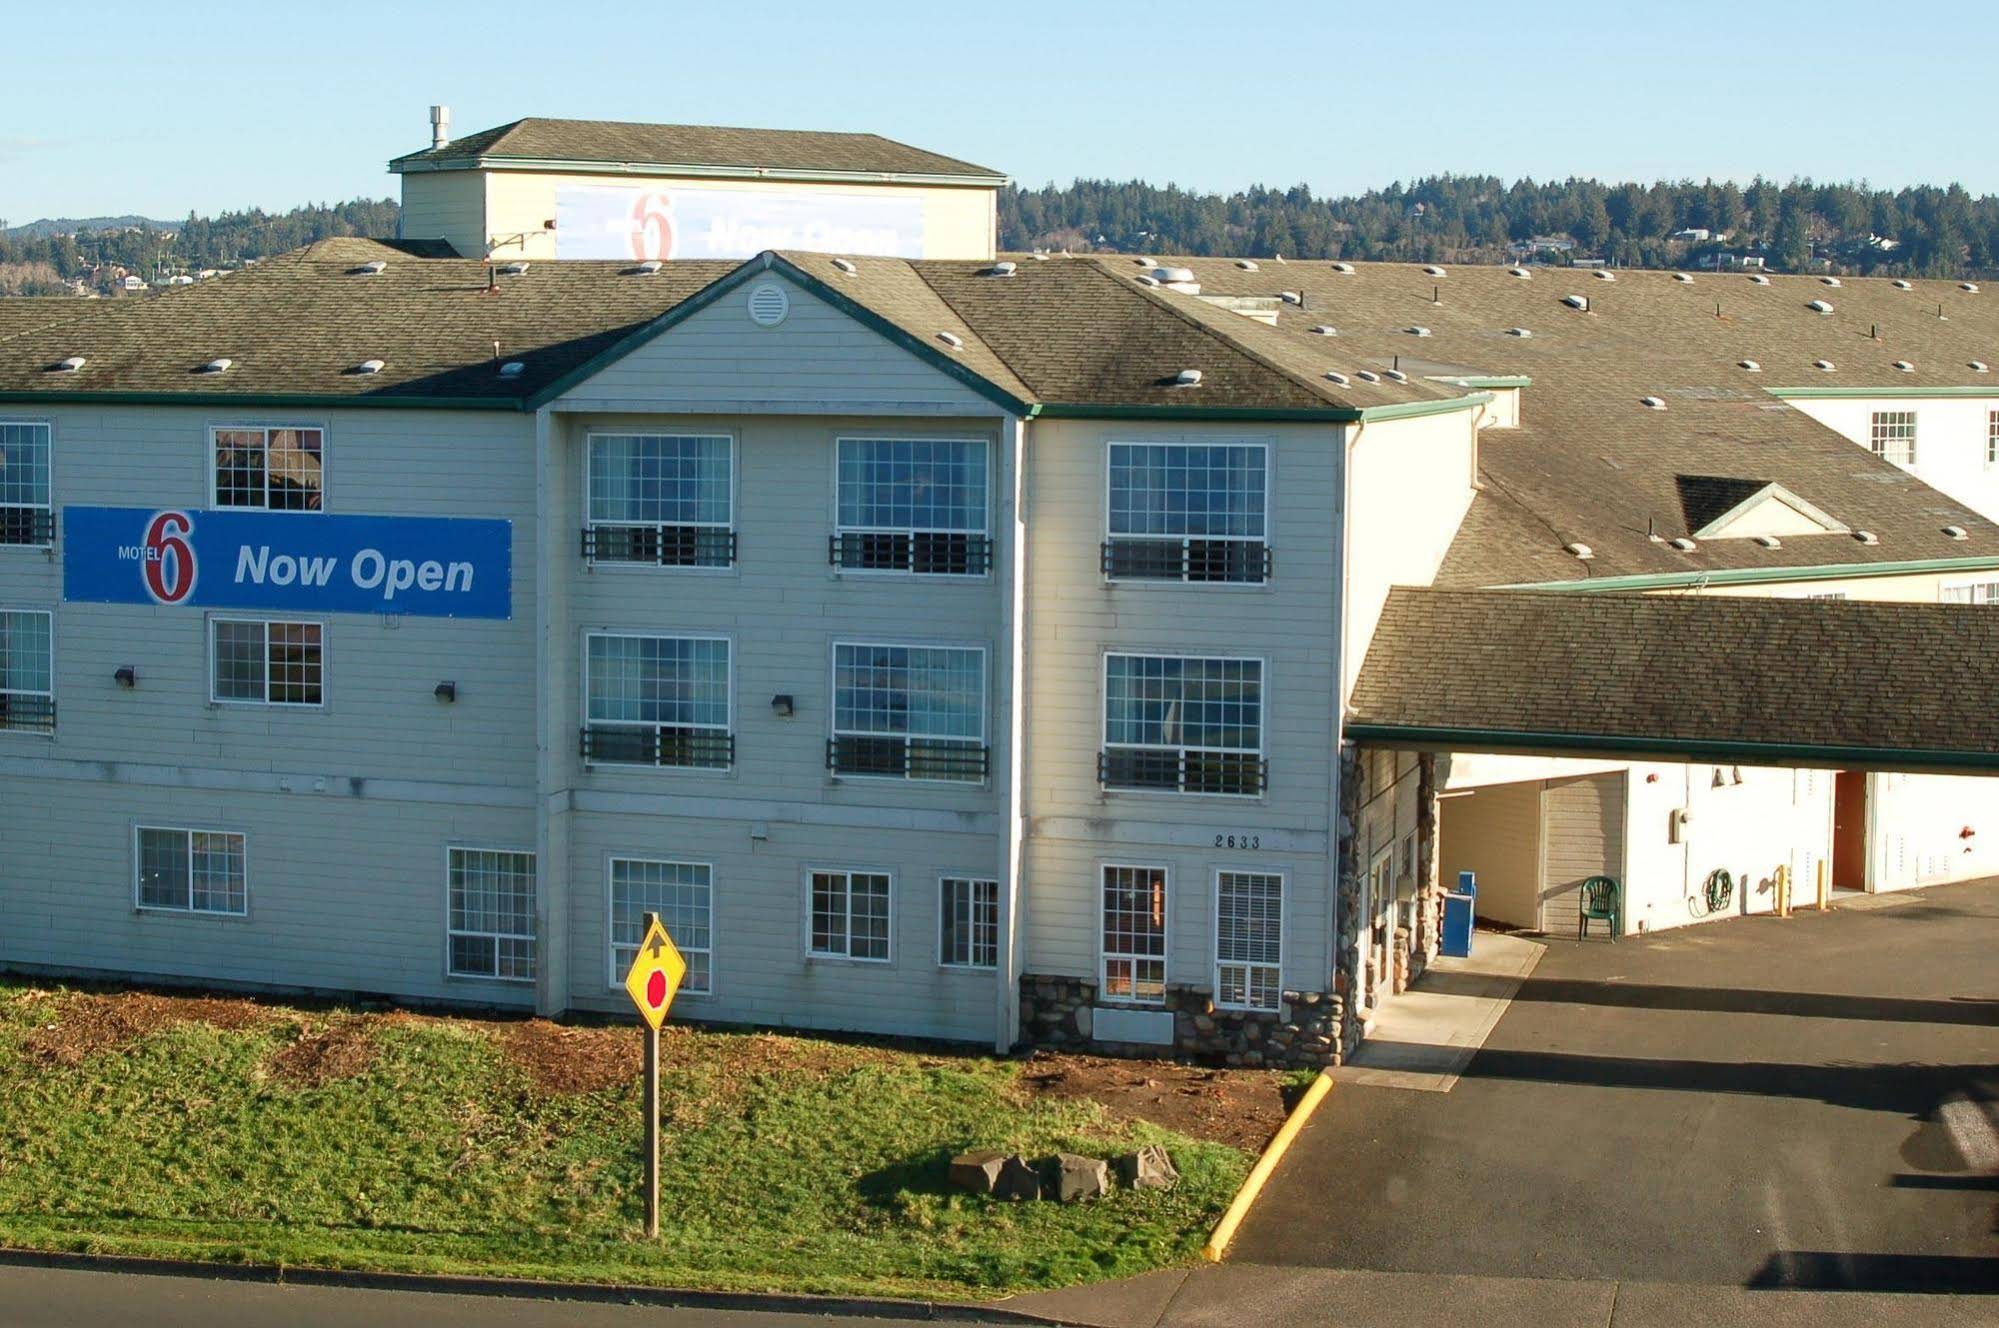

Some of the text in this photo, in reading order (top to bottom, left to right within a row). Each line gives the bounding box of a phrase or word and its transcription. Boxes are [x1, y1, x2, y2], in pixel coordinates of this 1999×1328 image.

[631, 193, 672, 260] 6
[118, 511, 195, 603] MOTEL 6
[234, 545, 474, 600] Now Open
[1215, 834, 1260, 849] 2633
